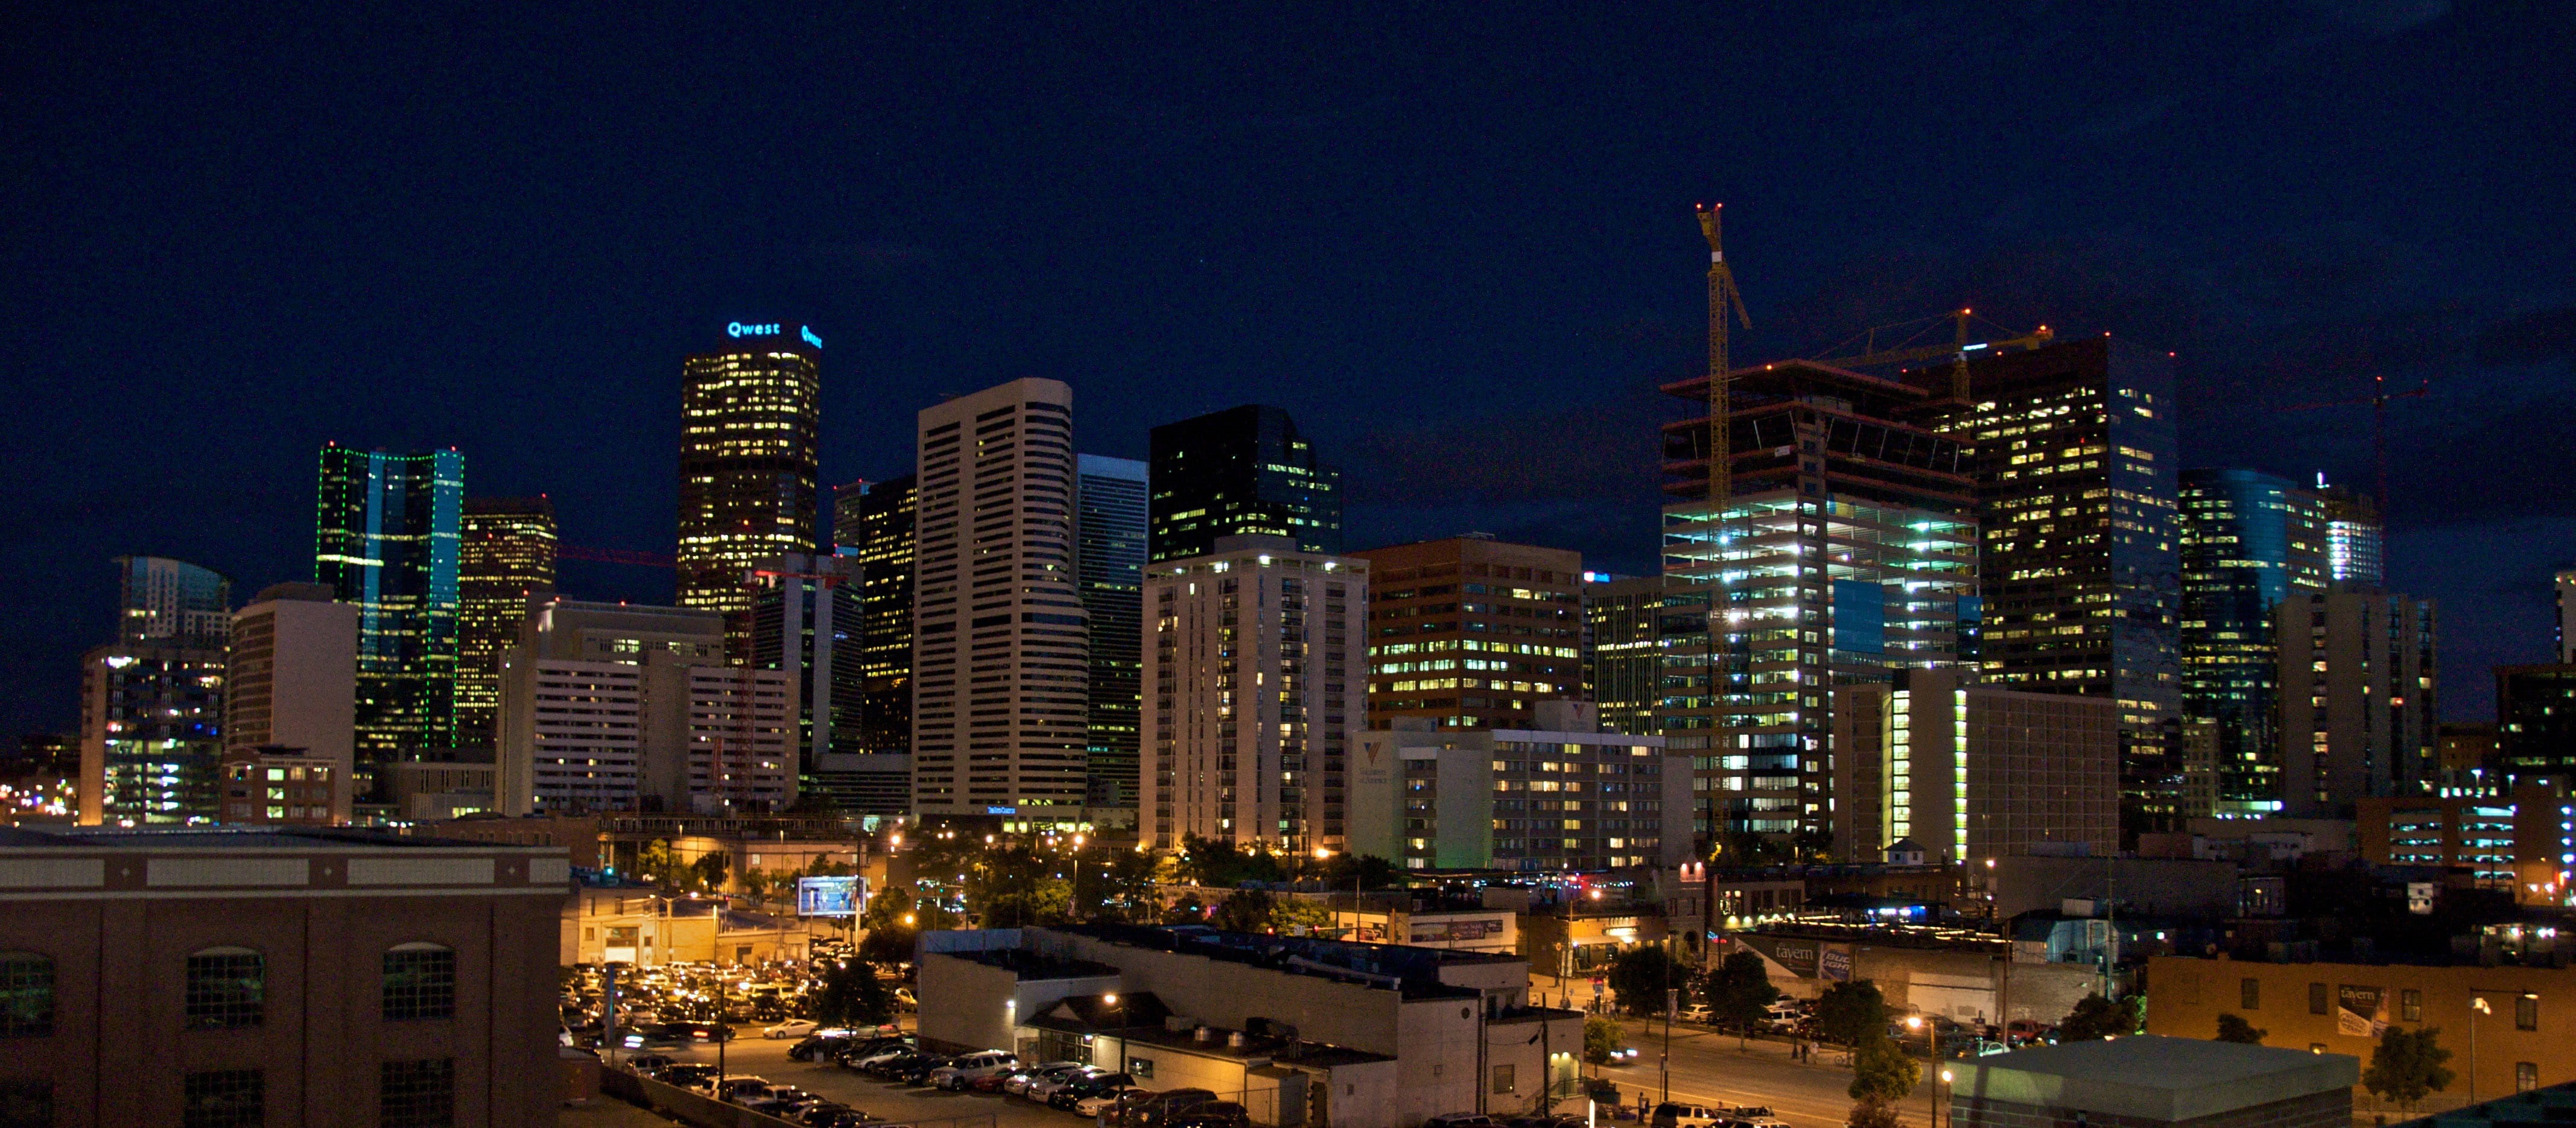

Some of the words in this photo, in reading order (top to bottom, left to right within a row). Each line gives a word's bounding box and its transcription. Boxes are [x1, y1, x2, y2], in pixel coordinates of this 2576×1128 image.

[728, 322, 780, 338] Qwest
[1776, 946, 1813, 960] tavern
[2341, 990, 2375, 1000] tavern
